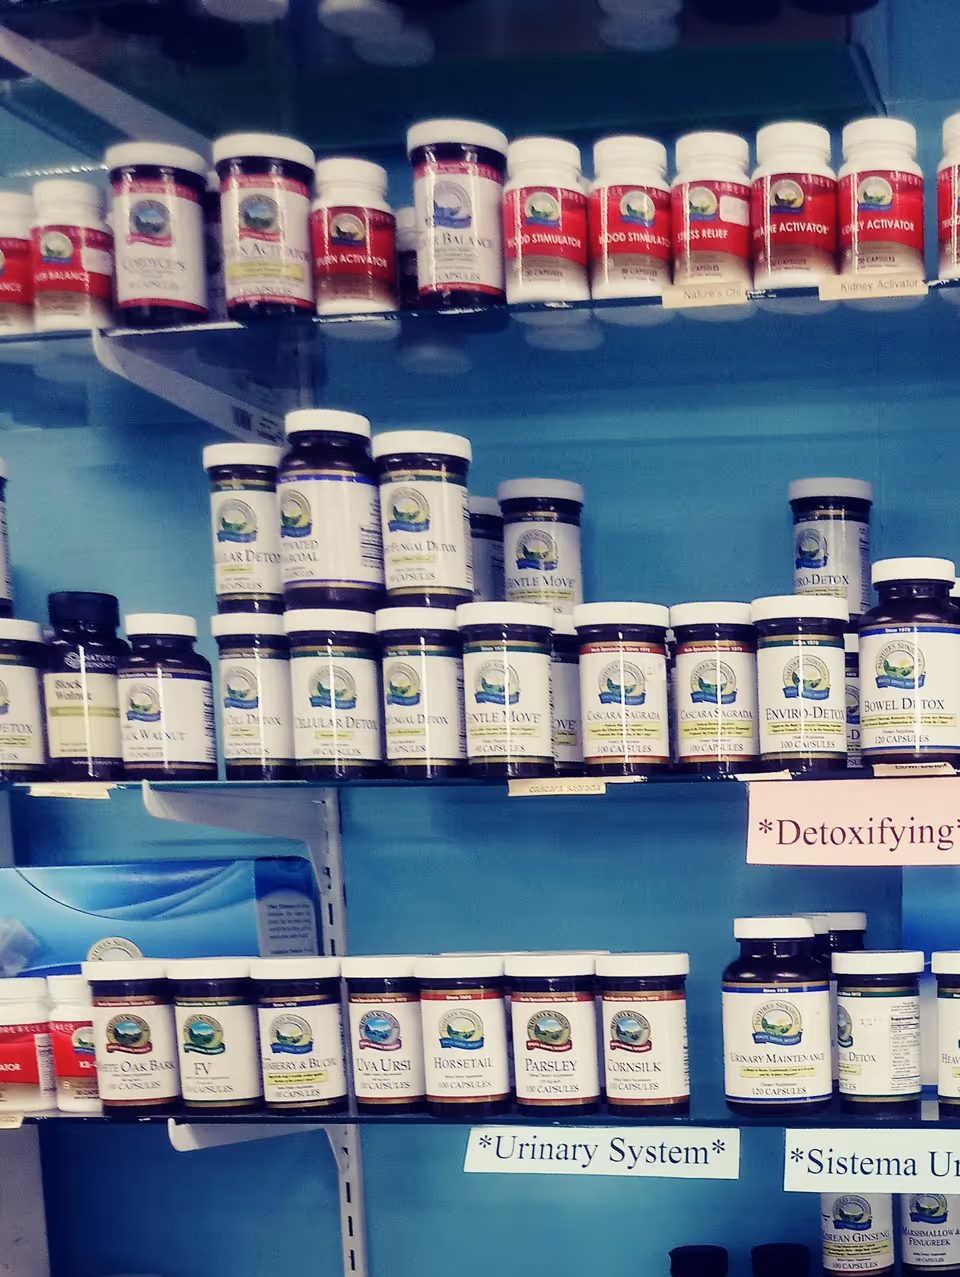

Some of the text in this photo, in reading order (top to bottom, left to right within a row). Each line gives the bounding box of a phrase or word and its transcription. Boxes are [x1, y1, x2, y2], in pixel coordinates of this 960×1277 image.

[840, 278, 919, 293] Kidney Activator
[864, 699, 899, 712] BOWEL
[525, 1058, 578, 1073] PARSLEY
